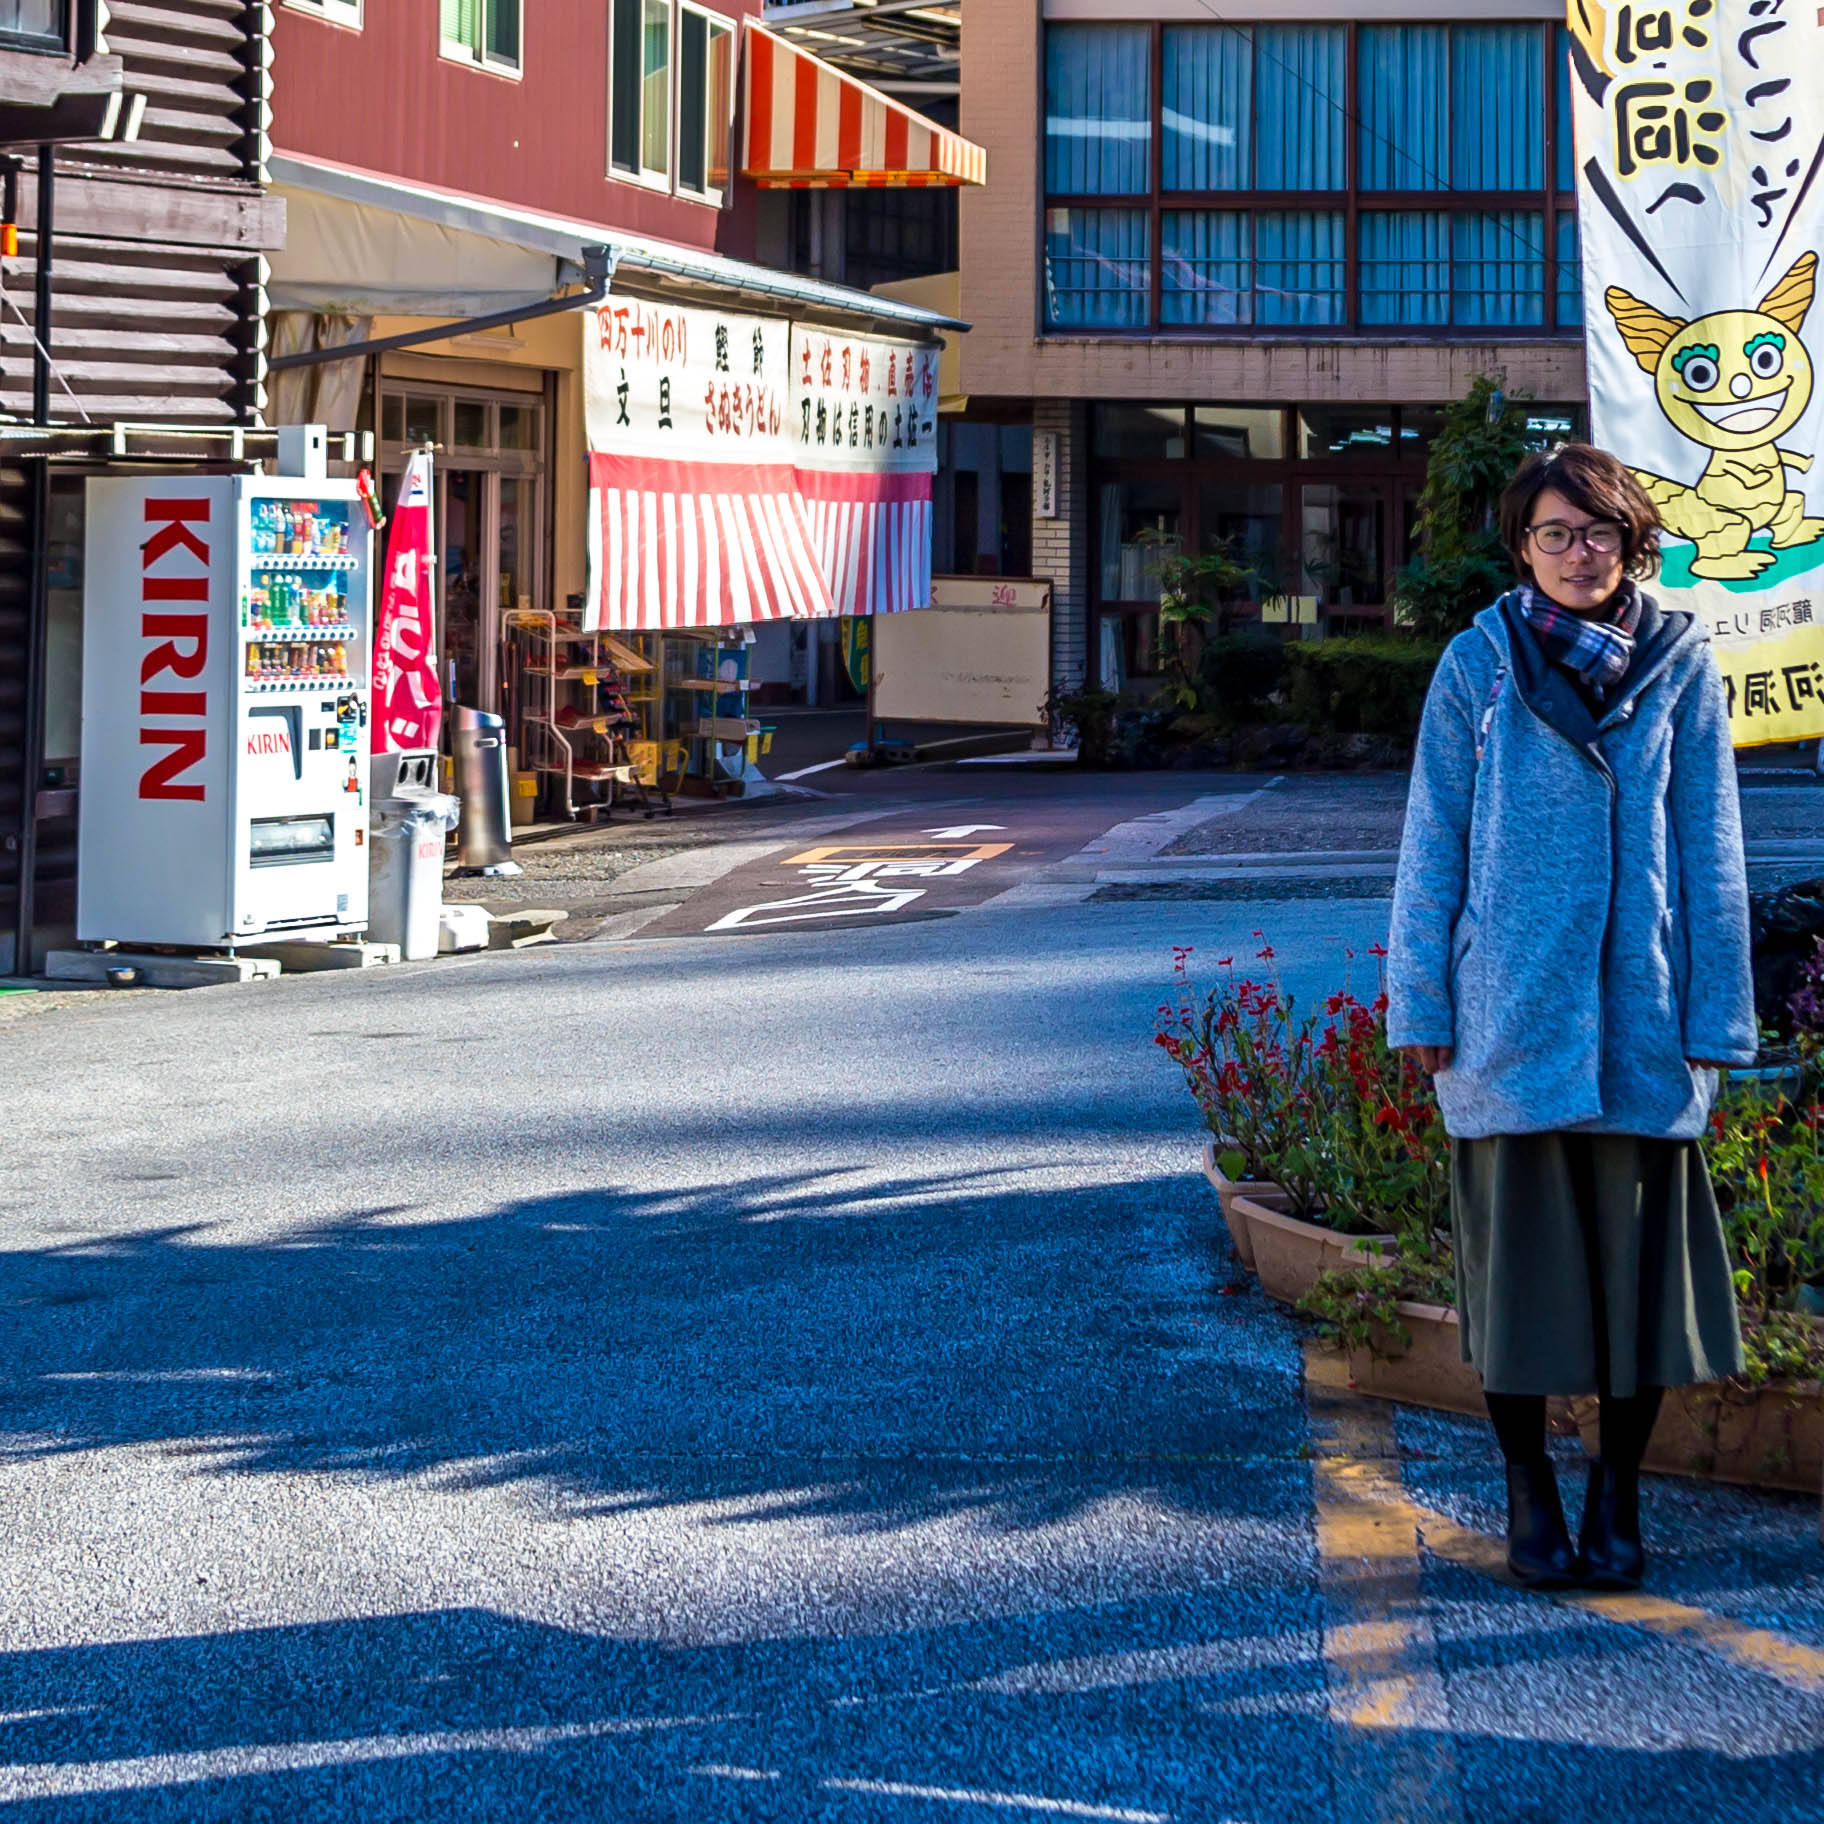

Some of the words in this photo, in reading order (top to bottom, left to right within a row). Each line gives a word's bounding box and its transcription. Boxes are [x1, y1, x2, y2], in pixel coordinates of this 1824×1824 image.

[597, 303, 688, 368] 四万十川のり
[616, 368, 674, 430] 文旦
[704, 379, 782, 438] さぬきうどん
[139, 497, 212, 803] KIRIN
[247, 732, 291, 755] KIRIN
